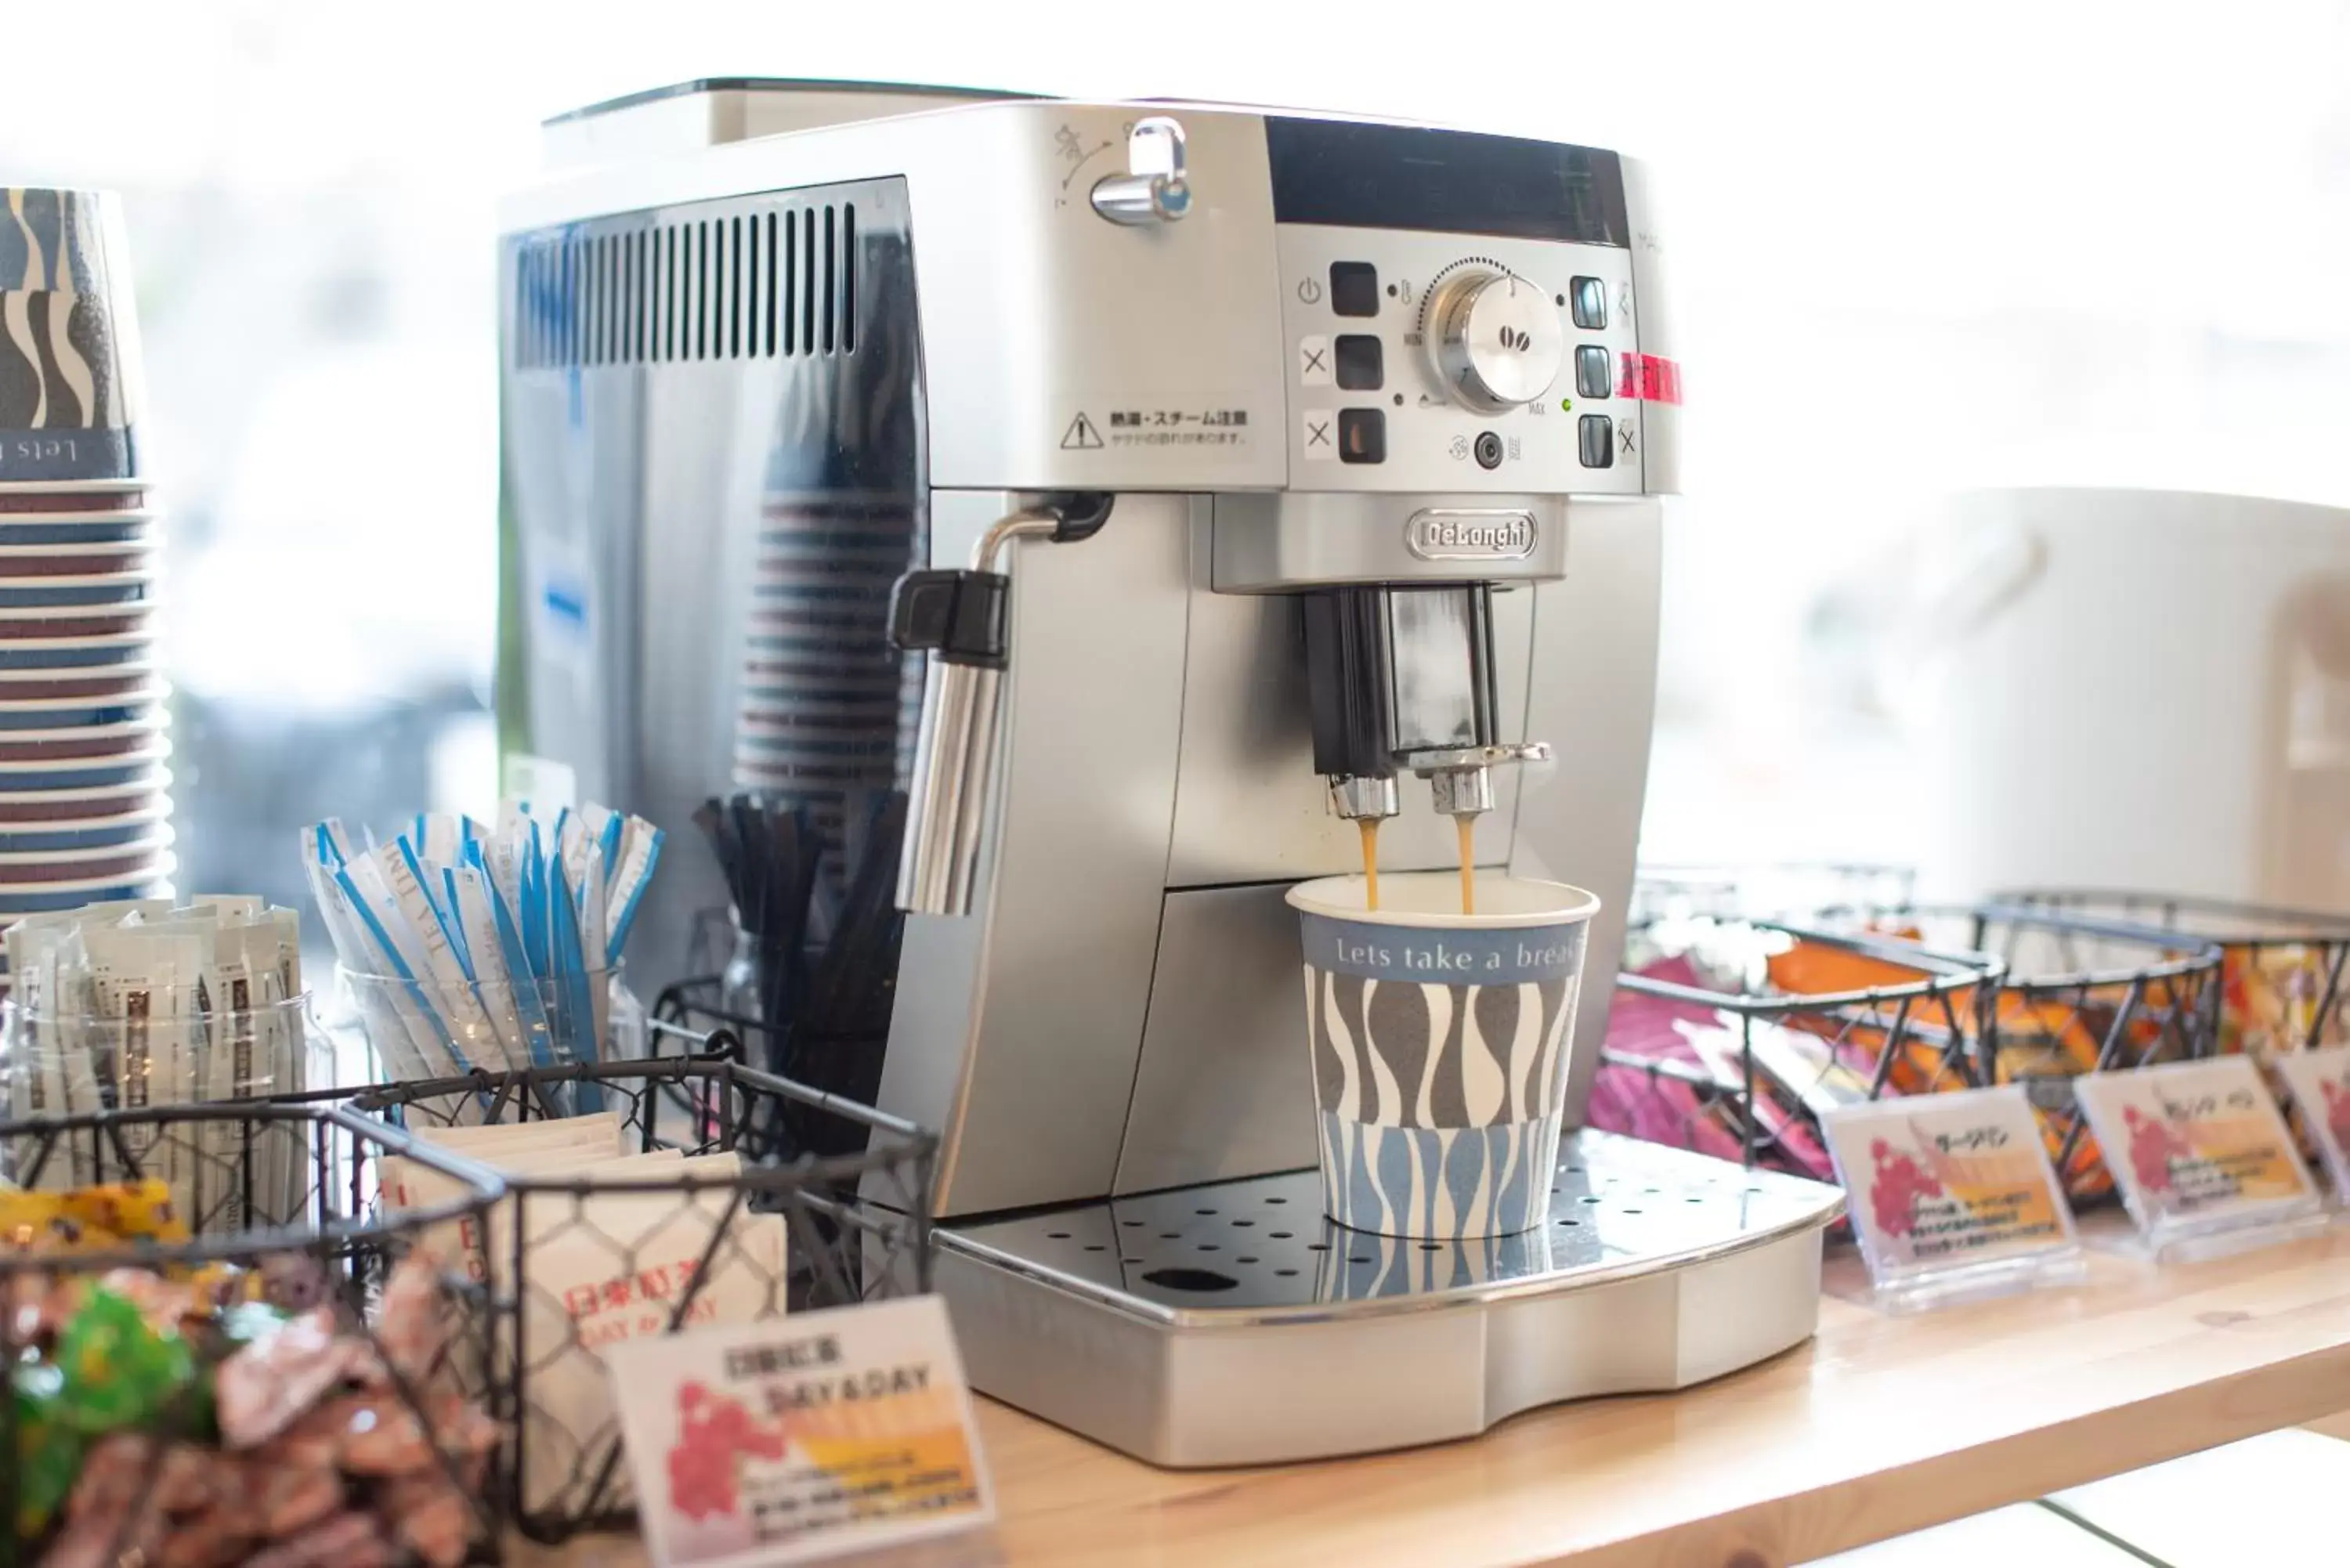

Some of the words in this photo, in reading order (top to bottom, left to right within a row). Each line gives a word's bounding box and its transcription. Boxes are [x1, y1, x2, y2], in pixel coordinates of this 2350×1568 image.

[1336, 938, 1391, 967] Lets
[1405, 943, 1473, 970] take
[1486, 952, 1502, 970] a
